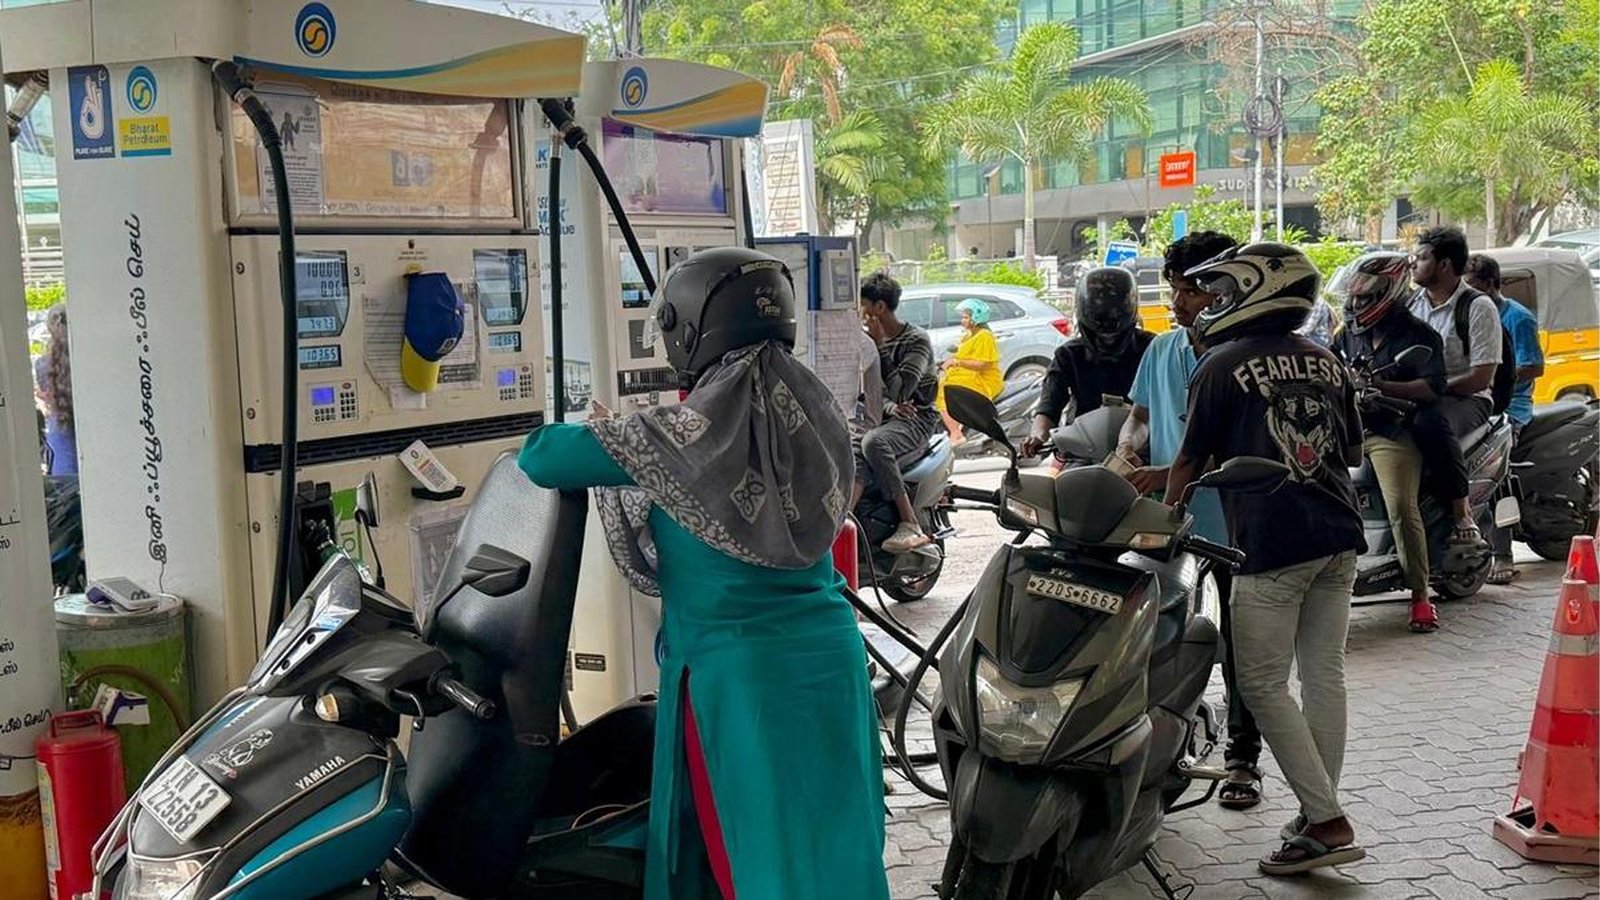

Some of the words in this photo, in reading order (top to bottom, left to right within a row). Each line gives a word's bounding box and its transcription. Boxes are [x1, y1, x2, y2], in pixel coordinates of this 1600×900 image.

[123, 134, 169, 145] Petroleum
[130, 122, 160, 135] Bharat
[353, 266, 361, 278] 3
[1231, 355, 1342, 394] FEARLESS
[1080, 589, 1119, 611] 6662
[294, 754, 347, 791] YAMAHA
[168, 762, 199, 794] TN
[191, 781, 220, 812] 13
